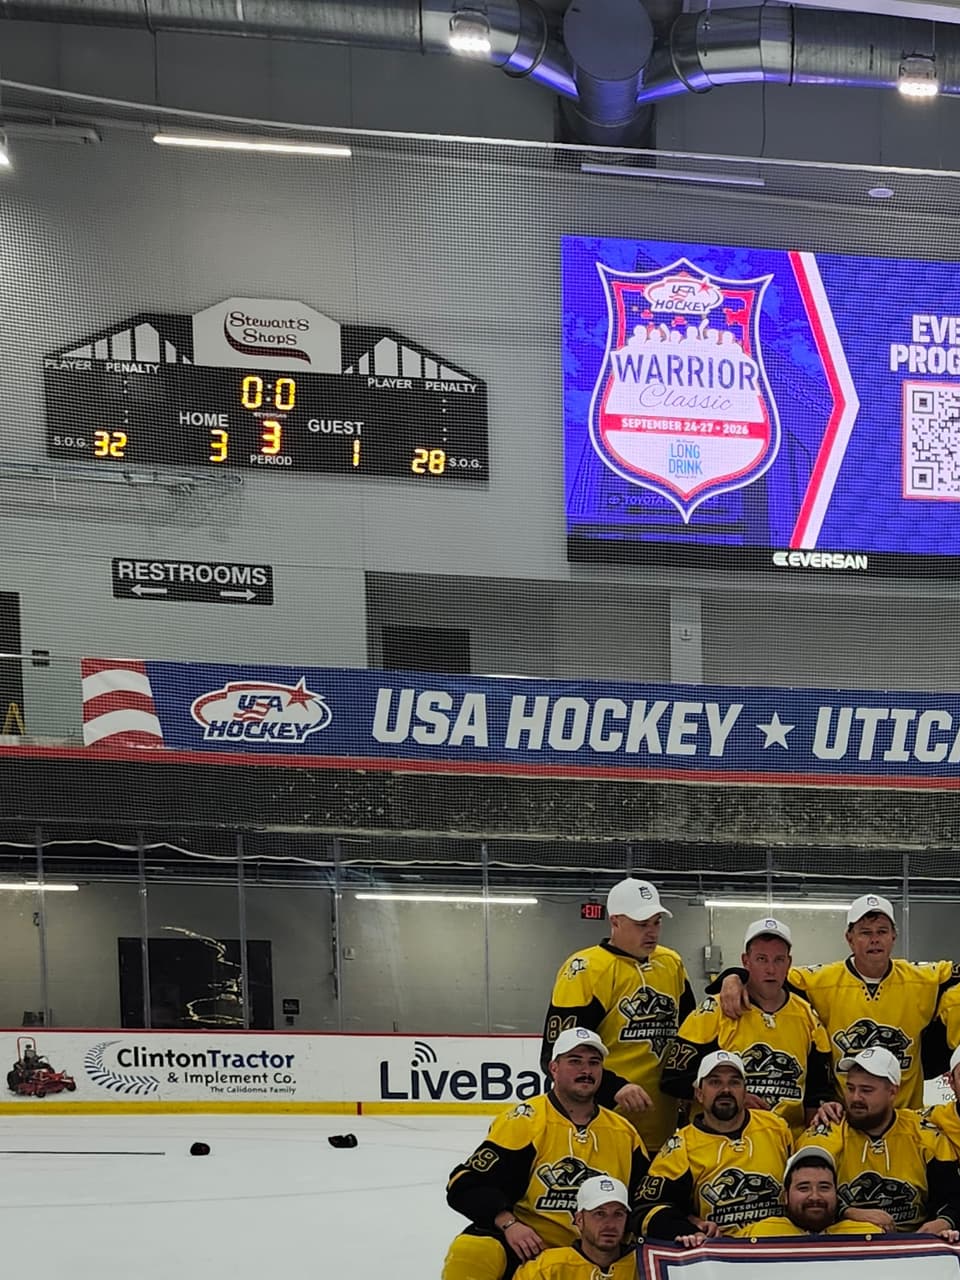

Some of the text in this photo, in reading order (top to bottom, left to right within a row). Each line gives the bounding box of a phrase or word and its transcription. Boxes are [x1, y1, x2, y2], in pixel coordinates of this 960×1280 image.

[655, 300, 711, 311] HOCKEY
[45, 359, 160, 374] PLAYER PENALTY
[615, 353, 757, 391] WARRIOR
[367, 378, 477, 392] PLAYER PENALTY
[639, 384, 733, 411] Classic
[179, 411, 229, 427] HOME
[308, 419, 364, 435] GUEST
[621, 418, 749, 435] SEPTEMBER 24-27 2026
[94, 431, 127, 457] 32
[210, 430, 228, 462] 3
[261, 420, 282, 455] 3
[353, 440, 360, 466] 1
[670, 443, 700, 459] LONG
[250, 455, 292, 466] PERIOD
[412, 449, 445, 474] 28
[669, 458, 703, 475] DRINK
[789, 553, 867, 569] EVERSAN
[118, 560, 268, 585] RESTROOMS
[238, 695, 283, 712] USA
[207, 720, 311, 739] HOCKEY
[372, 687, 491, 748] USA
[504, 695, 743, 758] HOCKEY
[117, 1047, 295, 1069] ClintonTractor
[167, 1070, 296, 1087] & Implement Co.
[746, 1086, 800, 1097] ARRIORS
